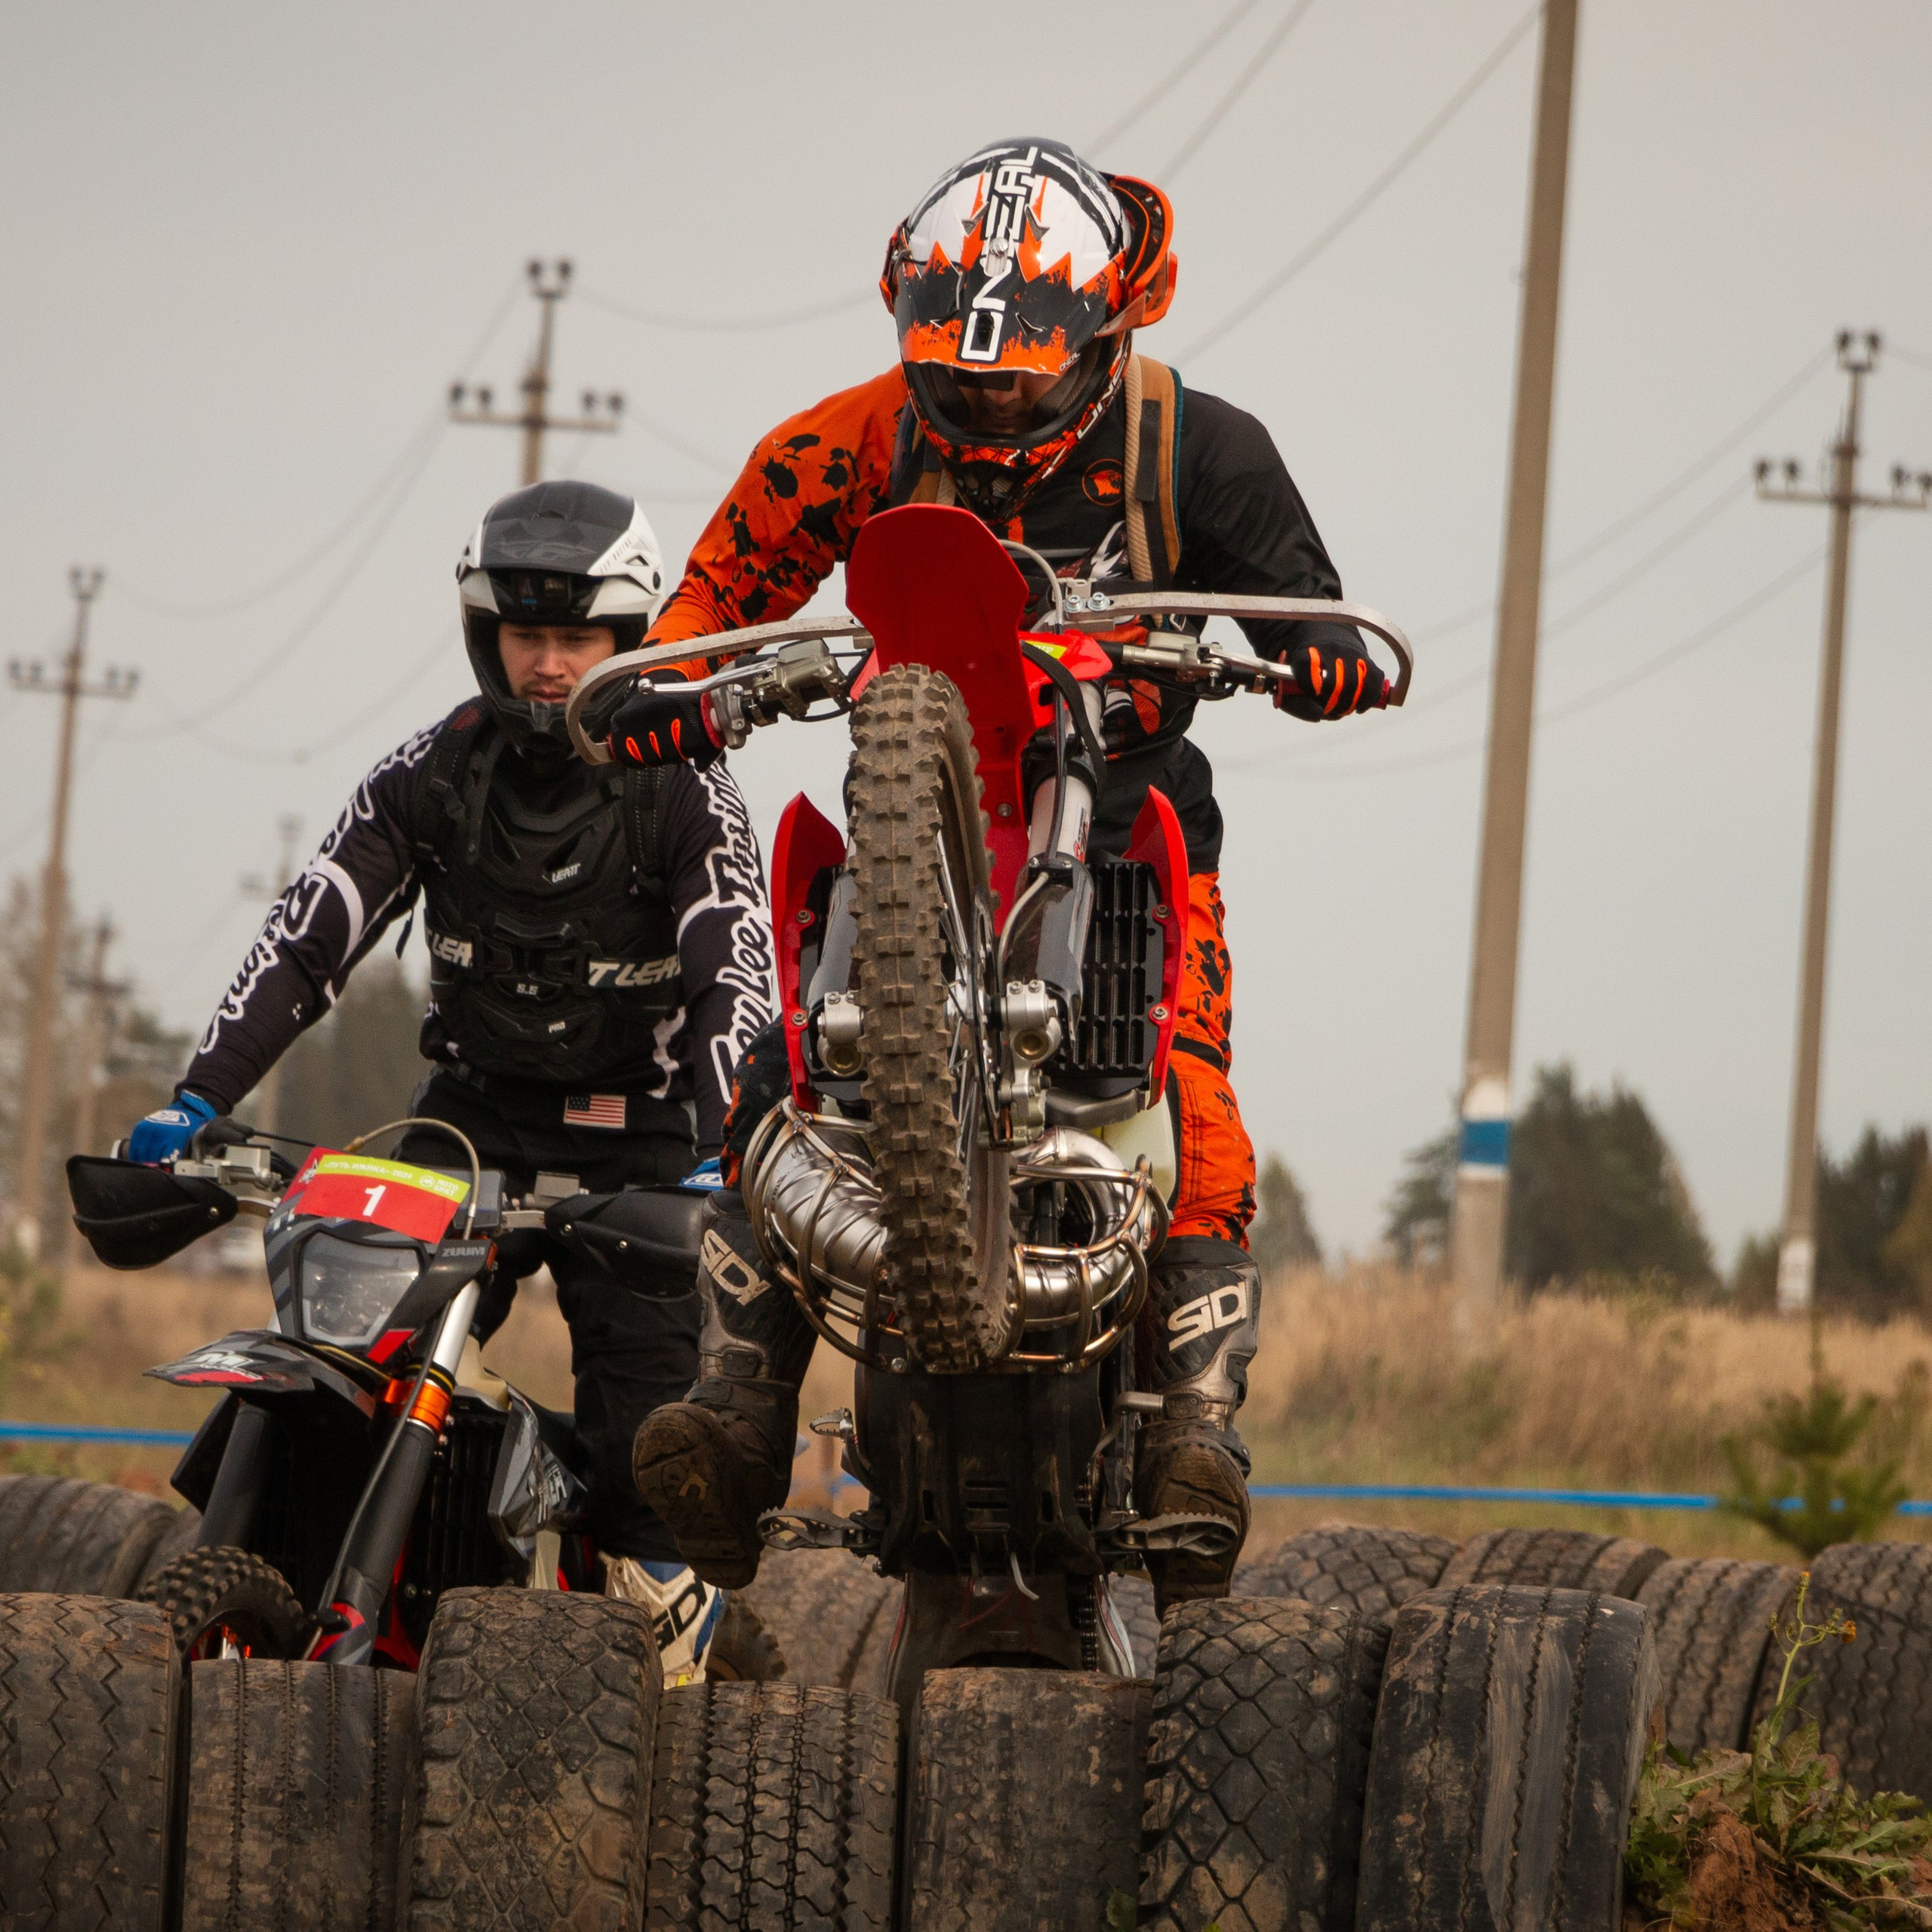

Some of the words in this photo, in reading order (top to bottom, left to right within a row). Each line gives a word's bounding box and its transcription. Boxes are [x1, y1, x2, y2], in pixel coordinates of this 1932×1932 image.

[552, 862, 581, 883] LEATT
[516, 983, 538, 995] 5.5
[549, 1021, 565, 1033] PRO
[392, 1169, 412, 1179] 2024
[363, 1185, 386, 1217] 1
[700, 1229, 773, 1306] SIDI
[1168, 1281, 1247, 1352] SIDI
